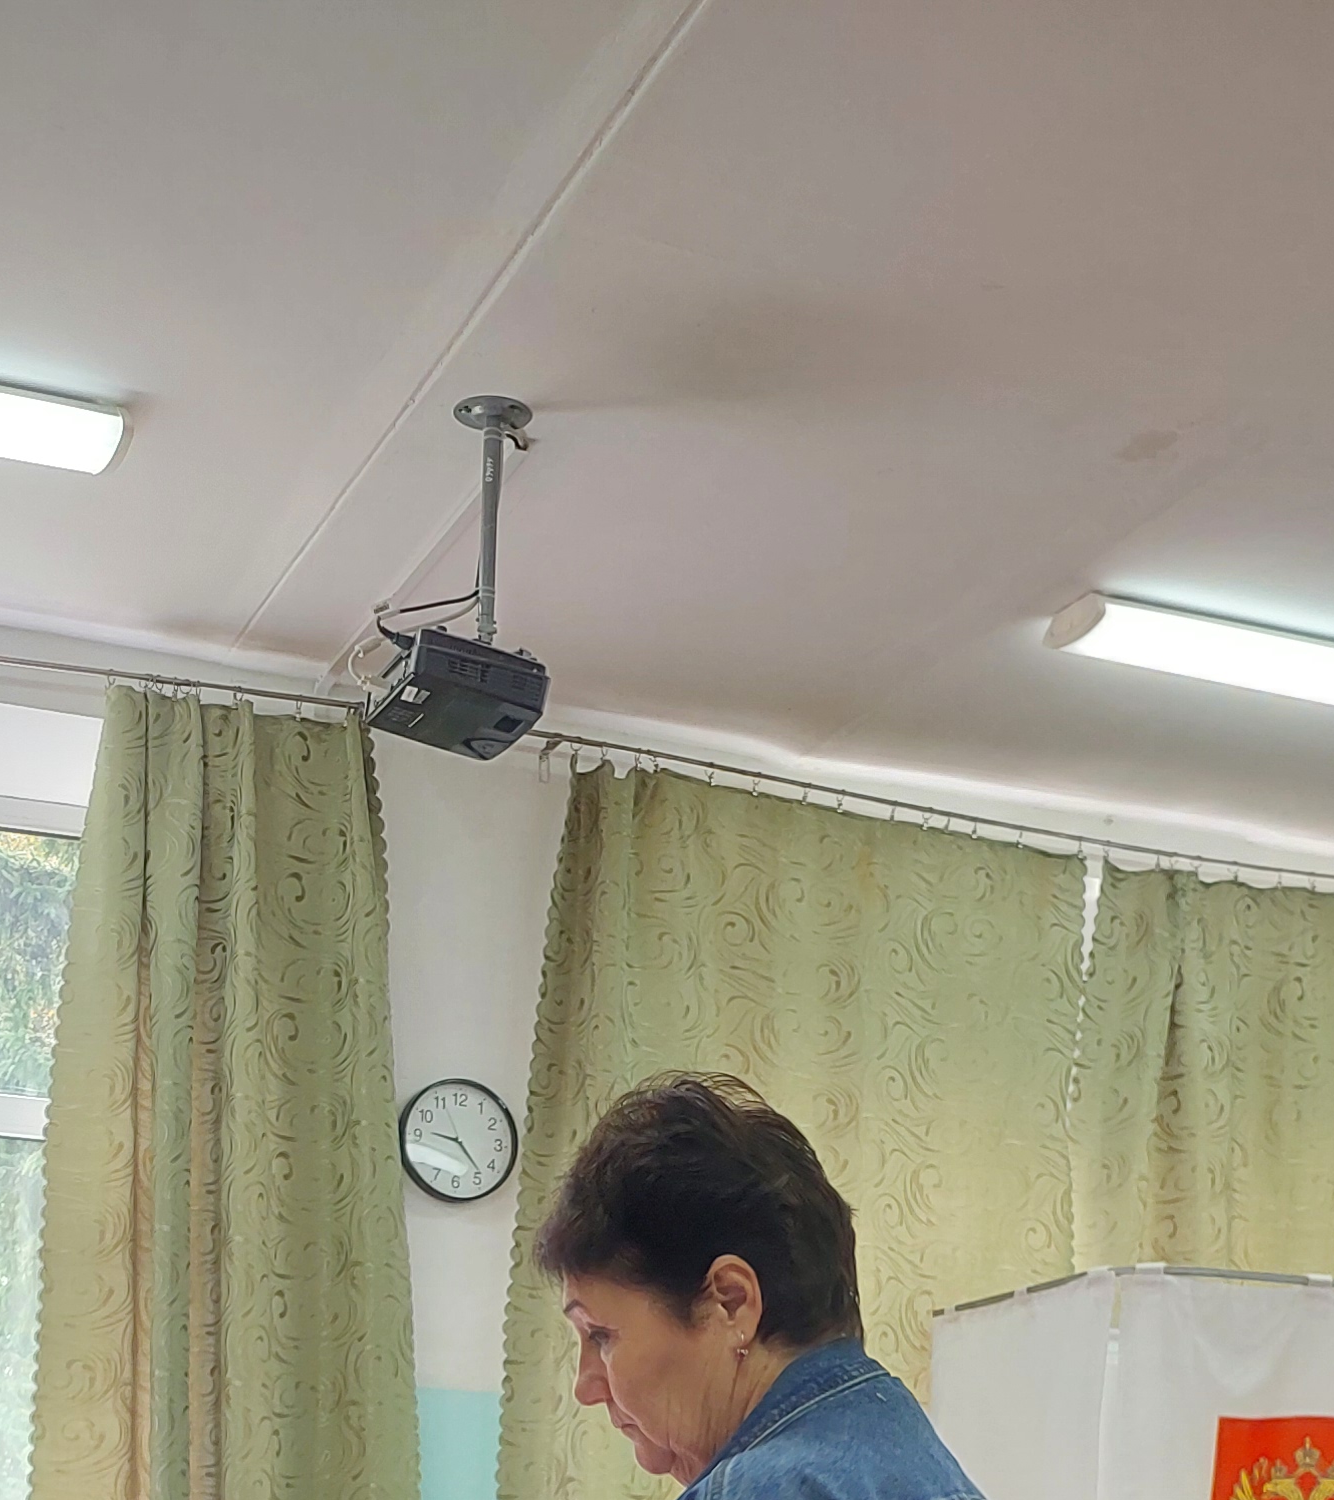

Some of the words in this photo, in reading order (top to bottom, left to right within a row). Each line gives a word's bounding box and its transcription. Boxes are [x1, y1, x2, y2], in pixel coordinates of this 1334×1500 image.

[434, 1095, 446, 1109] 11
[452, 1093, 468, 1107] 12
[419, 1109, 433, 1123] 10
[488, 1117, 497, 1131] 2
[413, 1128, 423, 1142] 9
[494, 1139, 503, 1152] 3
[487, 1159, 496, 1172] 4
[432, 1168, 441, 1181] 7
[473, 1172, 482, 1185] 5
[451, 1175, 460, 1188] 6
